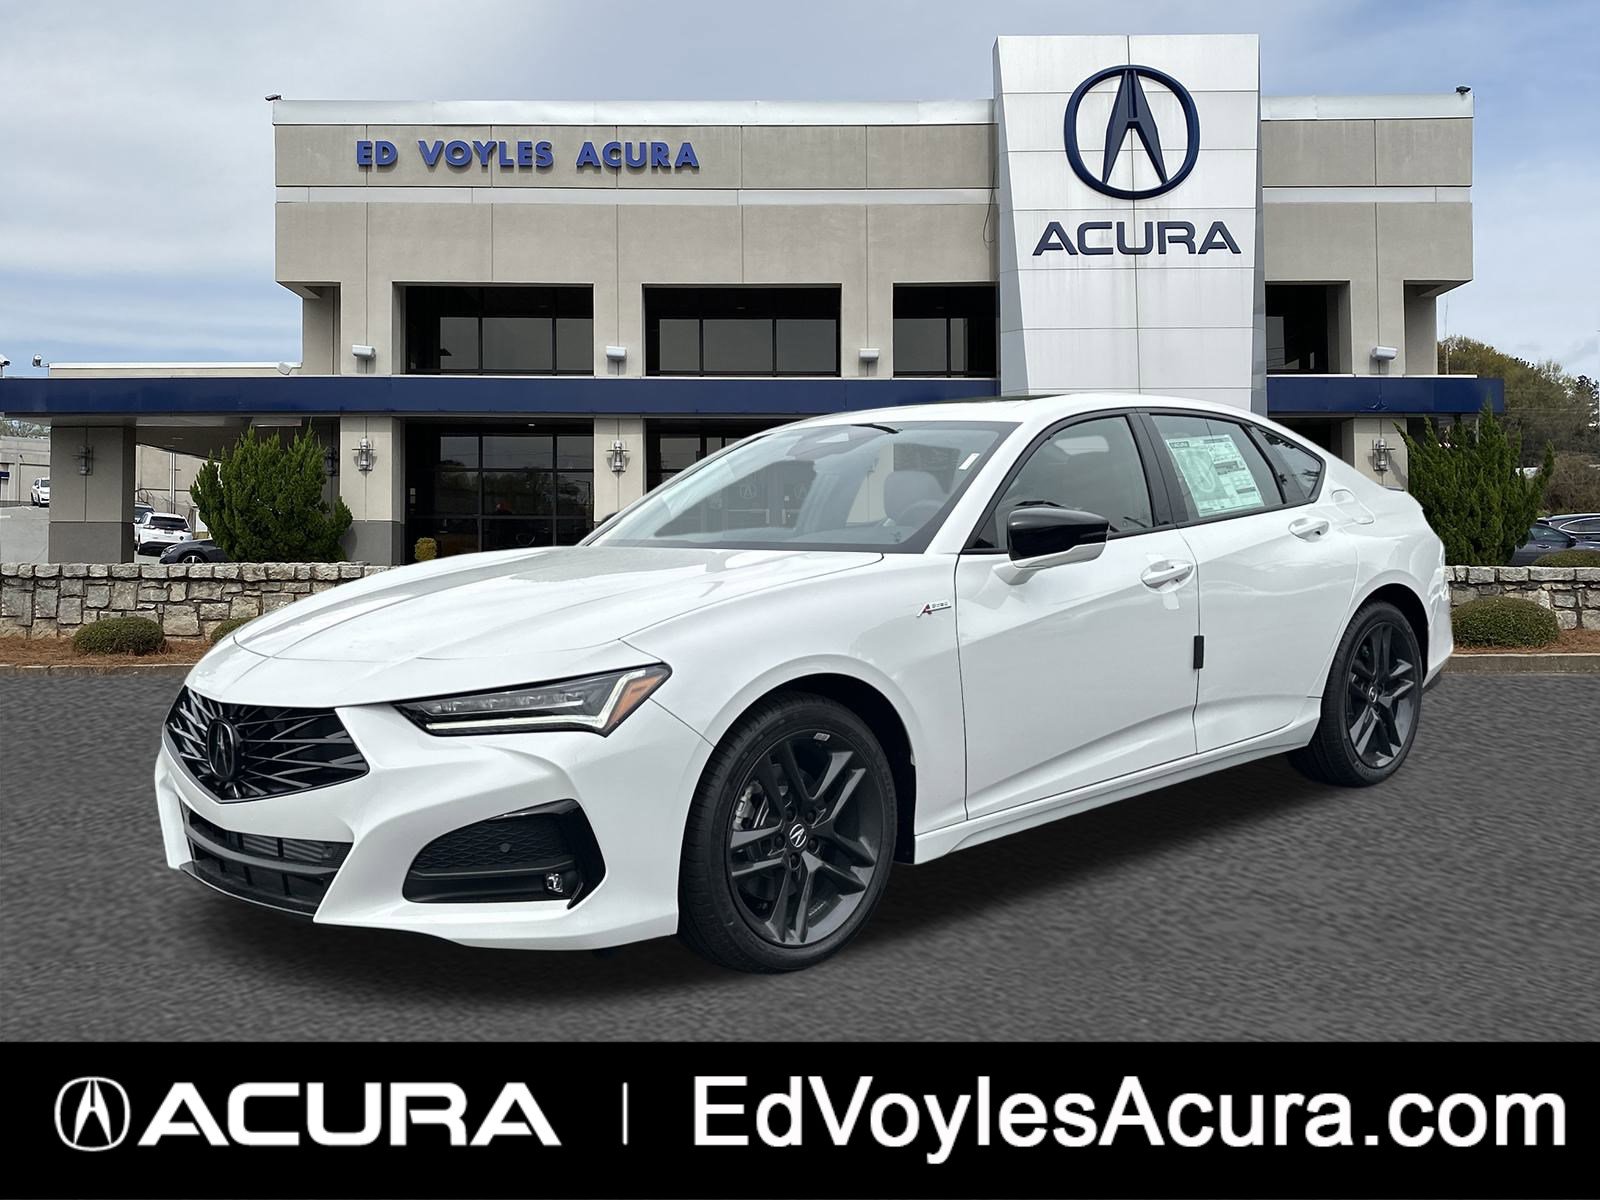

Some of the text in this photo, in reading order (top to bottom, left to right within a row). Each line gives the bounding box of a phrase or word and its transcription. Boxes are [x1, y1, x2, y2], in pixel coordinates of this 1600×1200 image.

[356, 140, 700, 169] ED VOYLES ACURA
[1032, 221, 1242, 256] ACURA
